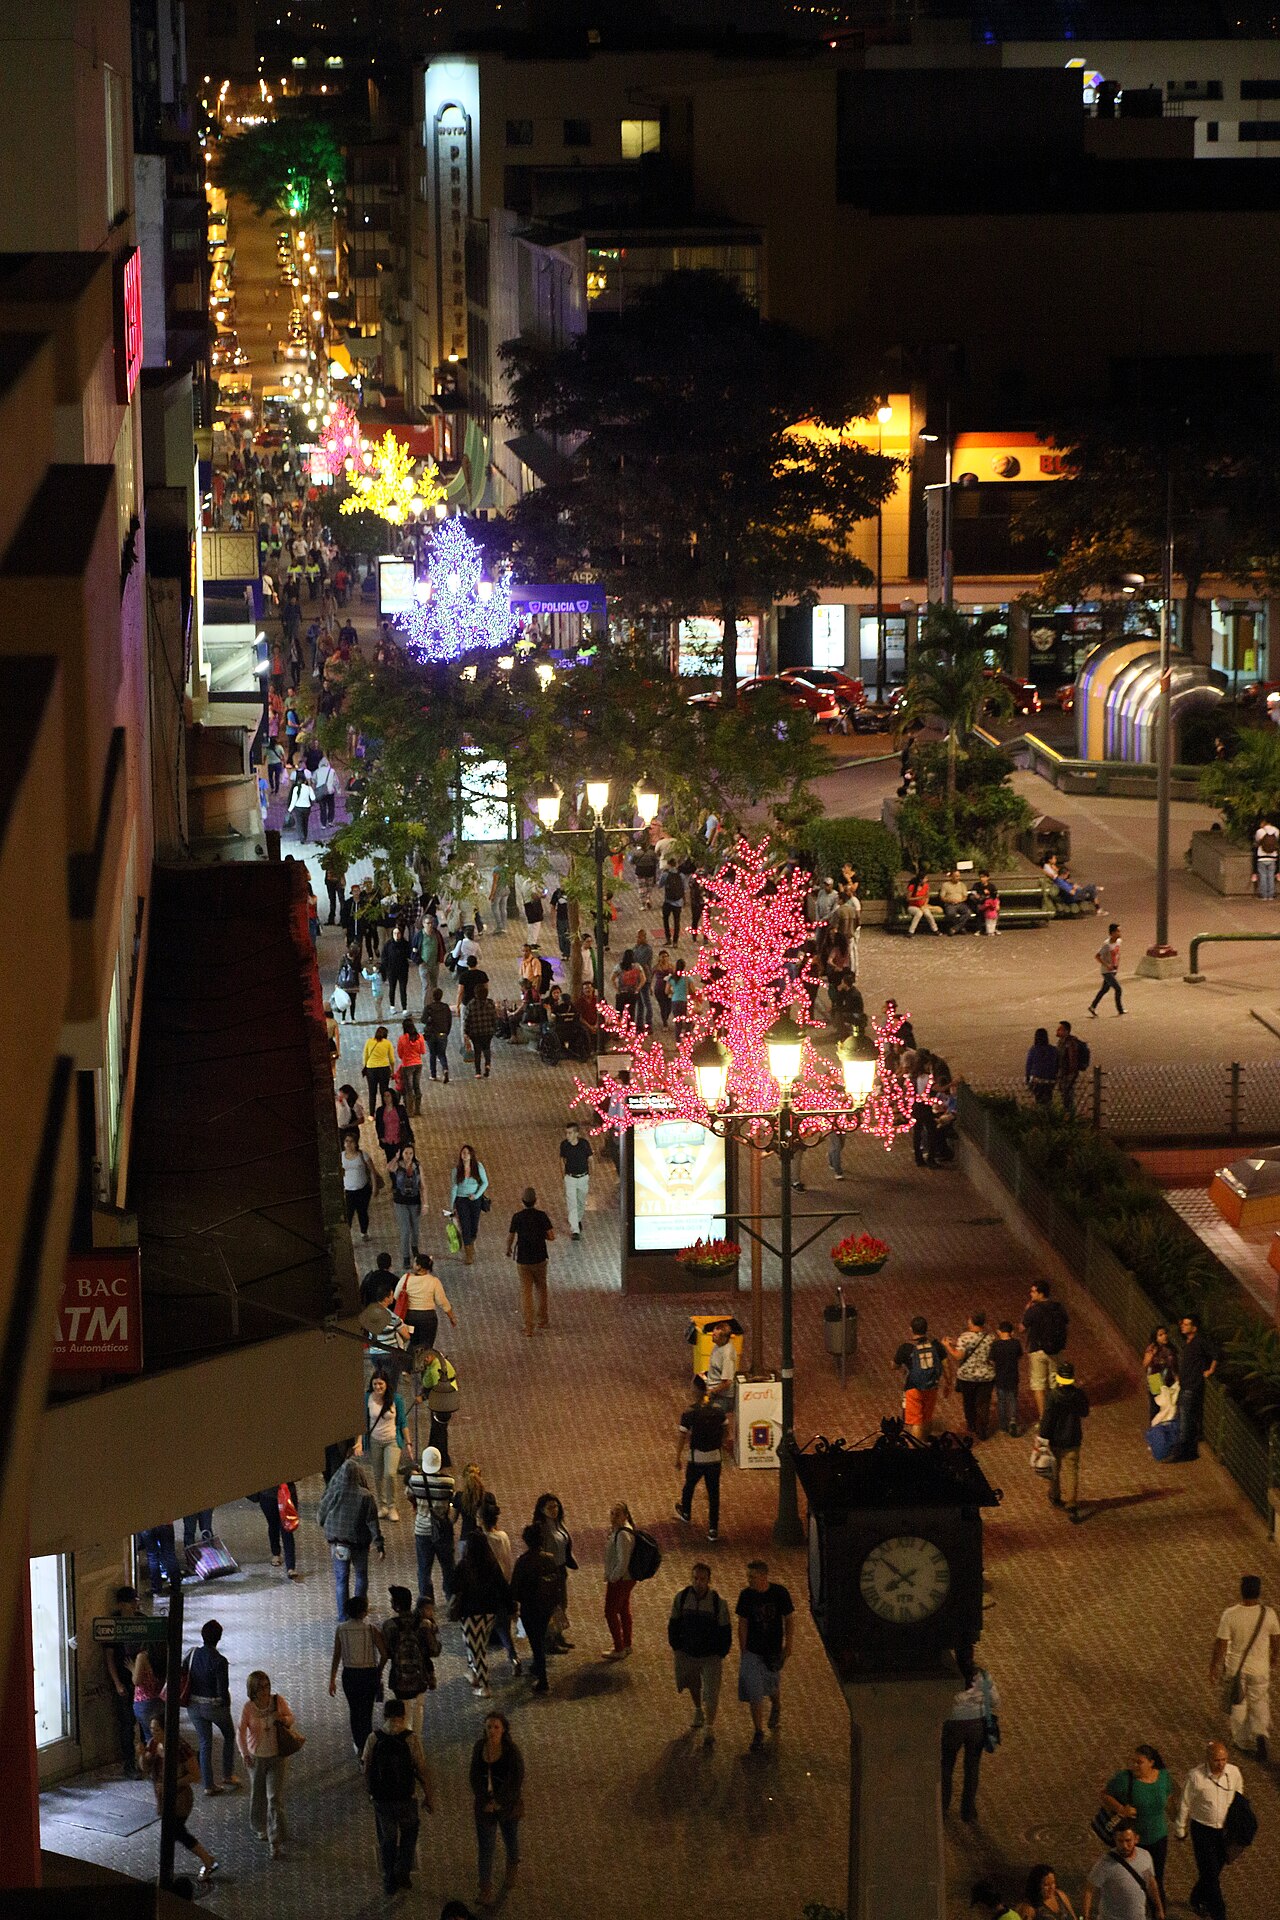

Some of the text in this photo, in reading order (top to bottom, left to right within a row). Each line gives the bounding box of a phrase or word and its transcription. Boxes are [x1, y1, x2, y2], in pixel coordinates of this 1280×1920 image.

[541, 602, 575, 612] POLICIA
[76, 1278, 128, 1297] BAC
[70, 1342, 129, 1353] Automáticos
